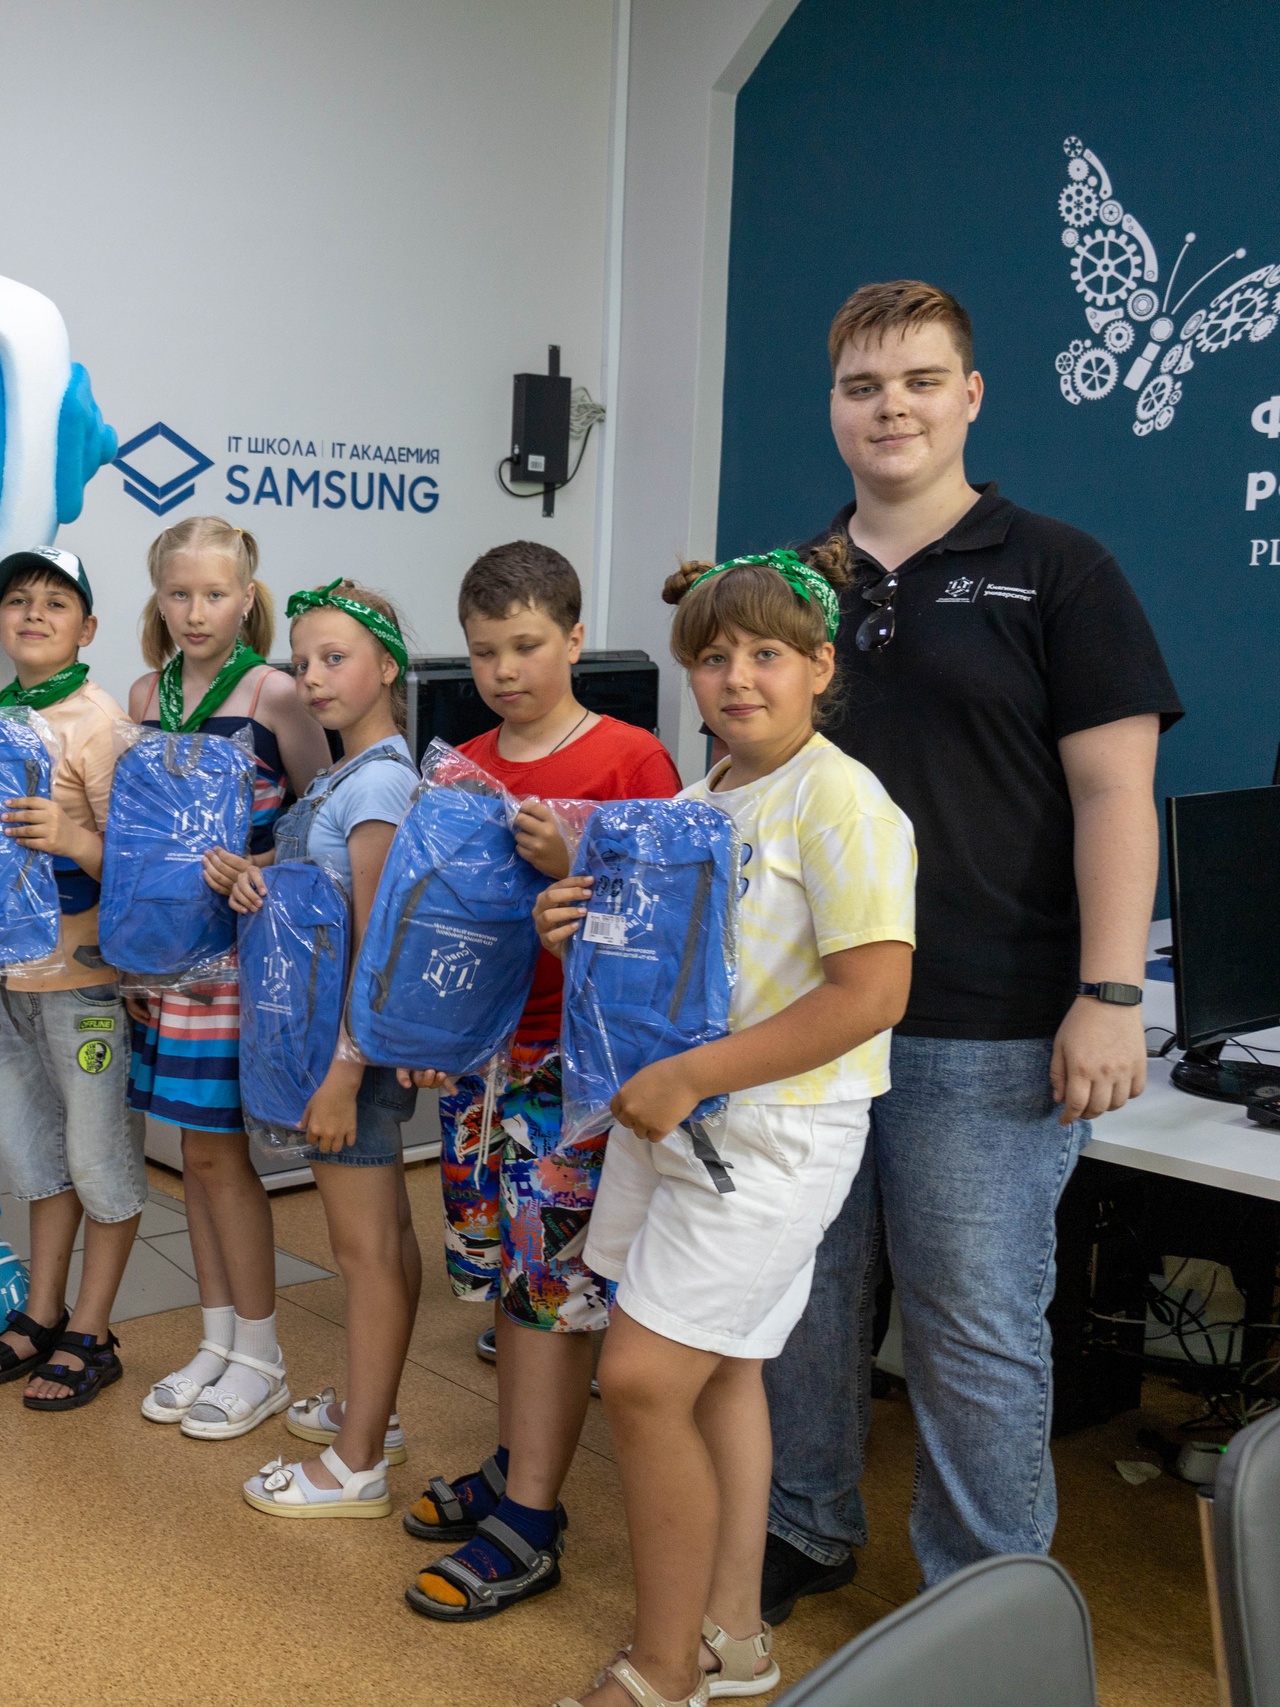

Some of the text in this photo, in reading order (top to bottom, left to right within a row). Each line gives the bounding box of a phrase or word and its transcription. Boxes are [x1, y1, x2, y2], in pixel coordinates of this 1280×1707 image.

[227, 436, 440, 465] IT ШКОЛА IT АКАДЕМИЯ
[226, 464, 440, 514] SAMSUNG
[444, 949, 469, 962] CUBE
